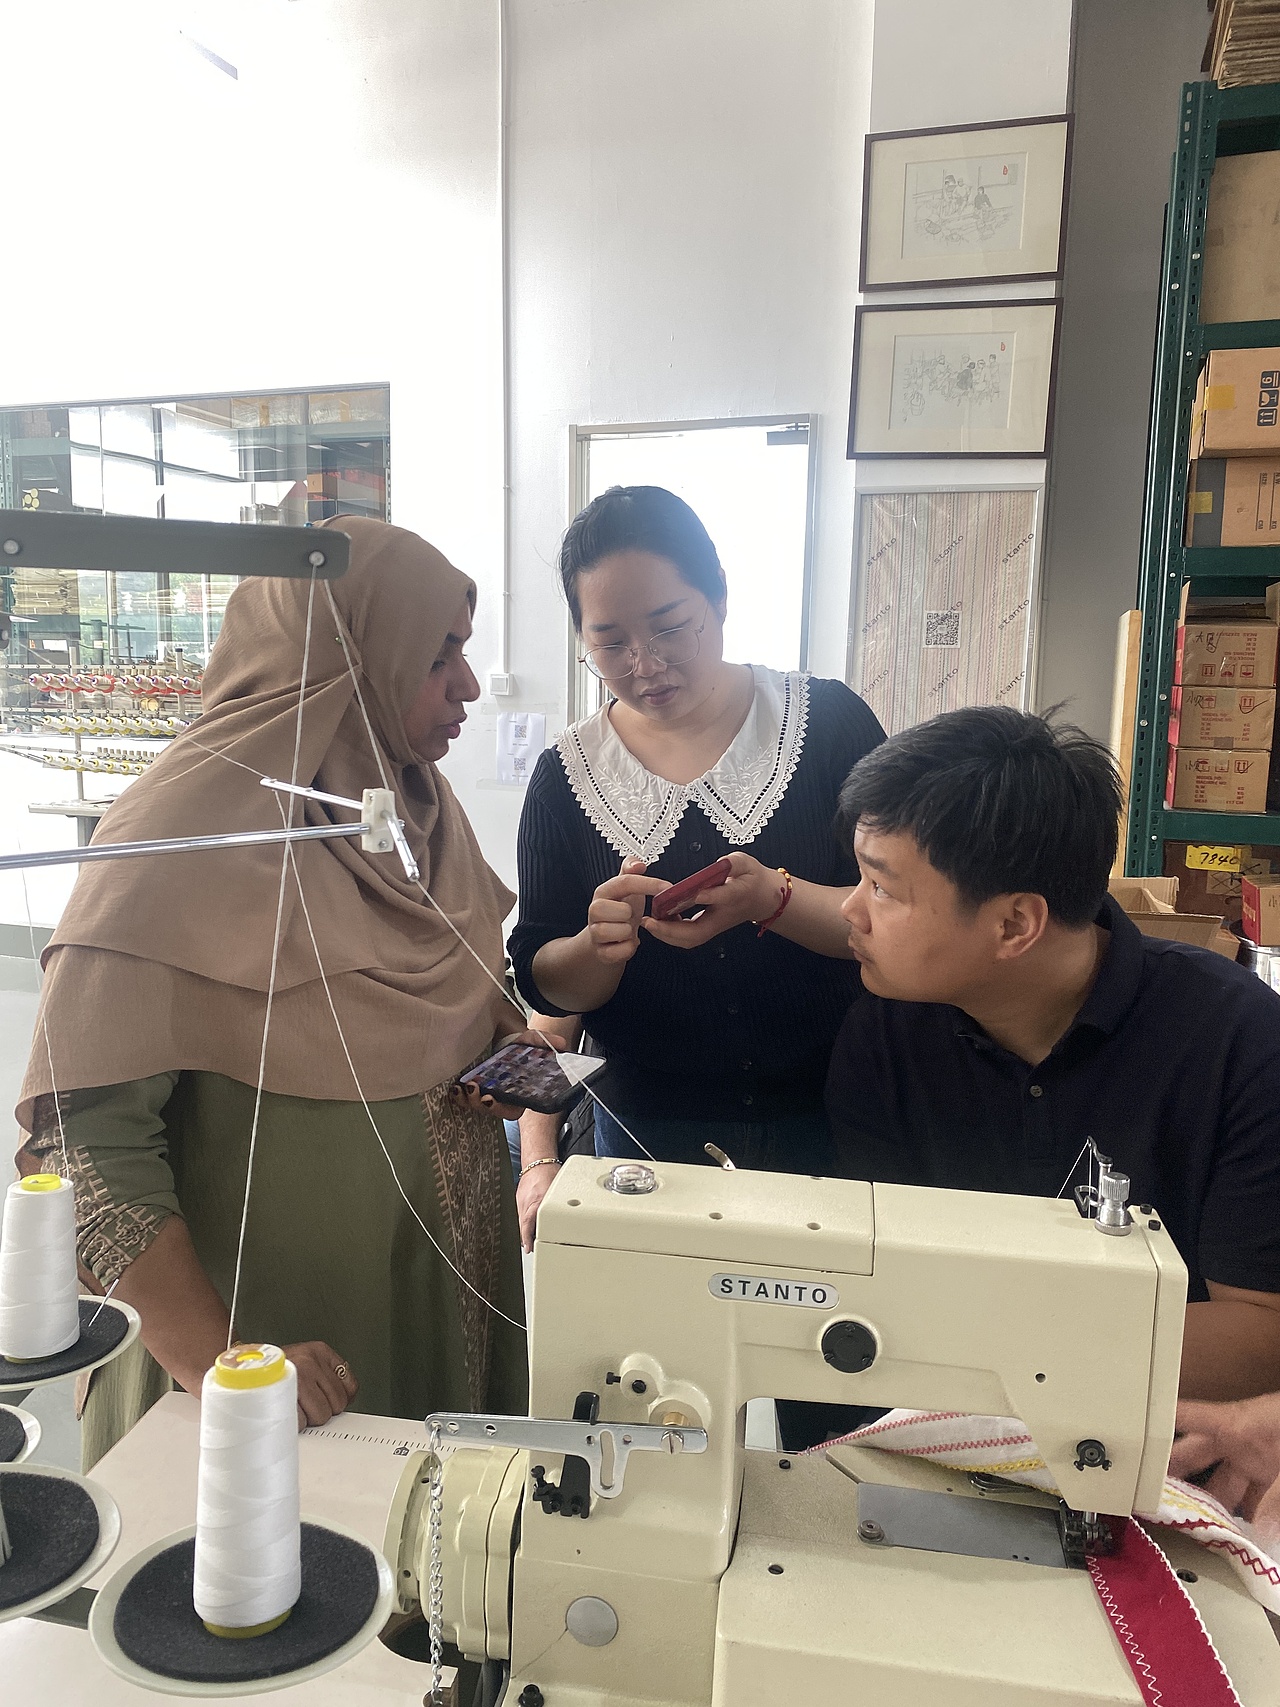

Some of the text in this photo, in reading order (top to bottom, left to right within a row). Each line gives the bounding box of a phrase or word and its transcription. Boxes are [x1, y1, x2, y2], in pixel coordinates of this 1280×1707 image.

[866, 537, 897, 567] stanto
[933, 535, 964, 564] stanto
[1002, 533, 1034, 564] stanto
[861, 604, 891, 634] stanto
[998, 599, 1030, 630] stanto
[859, 669, 889, 698] stanto
[927, 668, 959, 698] stanto
[720, 1278, 827, 1304] STANTO
